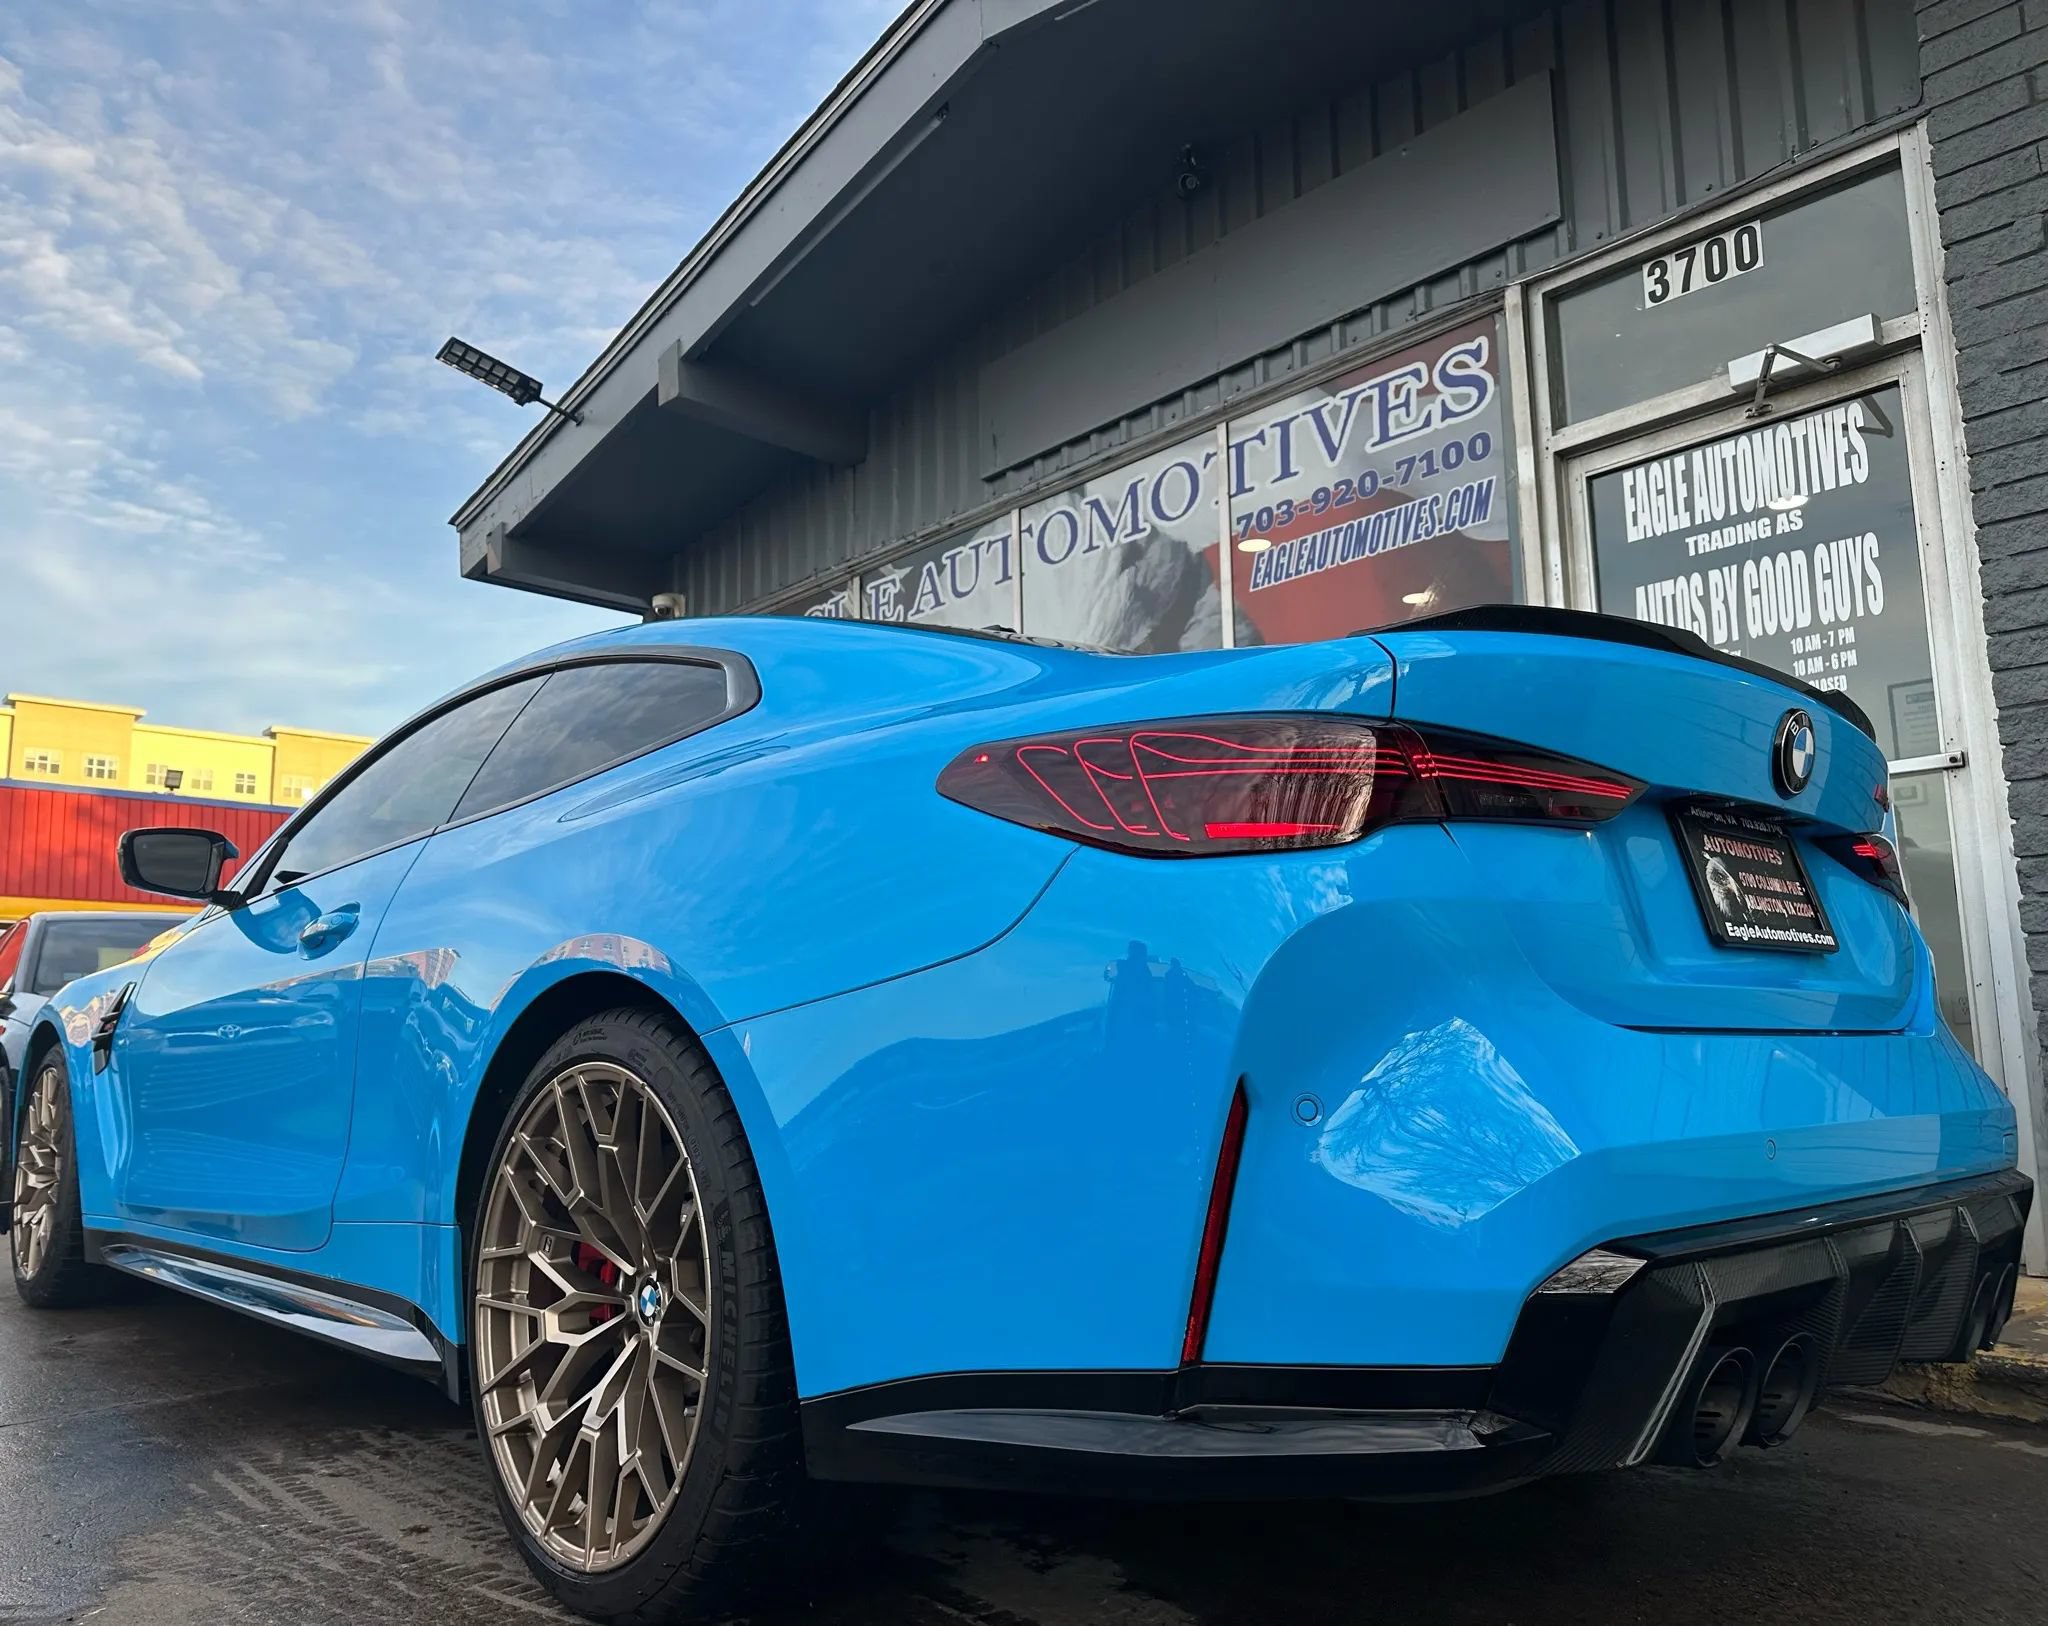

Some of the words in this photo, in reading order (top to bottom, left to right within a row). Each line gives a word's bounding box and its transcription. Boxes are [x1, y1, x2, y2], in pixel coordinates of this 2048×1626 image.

[1647, 225, 1760, 304] 3700
[908, 335, 1497, 620] AUTOMOTIVES
[1236, 431, 1492, 540] 703-920-7100
[1622, 455, 1691, 543] EAGLE
[1692, 402, 1869, 525] AUTOMOTIVES
[1250, 476, 1497, 592] EAGLEAUTOMOTIVES.COM
[1685, 517, 1771, 556] TRADING
[1775, 509, 1804, 535] AS
[1708, 564, 1740, 645] BY
[1743, 549, 1812, 640] GOOD
[1813, 532, 1884, 625] GUYS
[1790, 637, 1803, 655] 10
[1805, 633, 1821, 652] AM
[1828, 630, 1835, 647] 7
[1838, 626, 1855, 645] PM
[1793, 659, 1806, 677] 10
[1807, 656, 1824, 675] AM
[1831, 652, 1839, 670] 6
[1840, 649, 1857, 668] PM
[1703, 834, 1783, 866] AUTOMOTIVES
[1725, 921, 1836, 946] EagleAutomotives.com
[712, 1250, 738, 1435] MICHELIN
